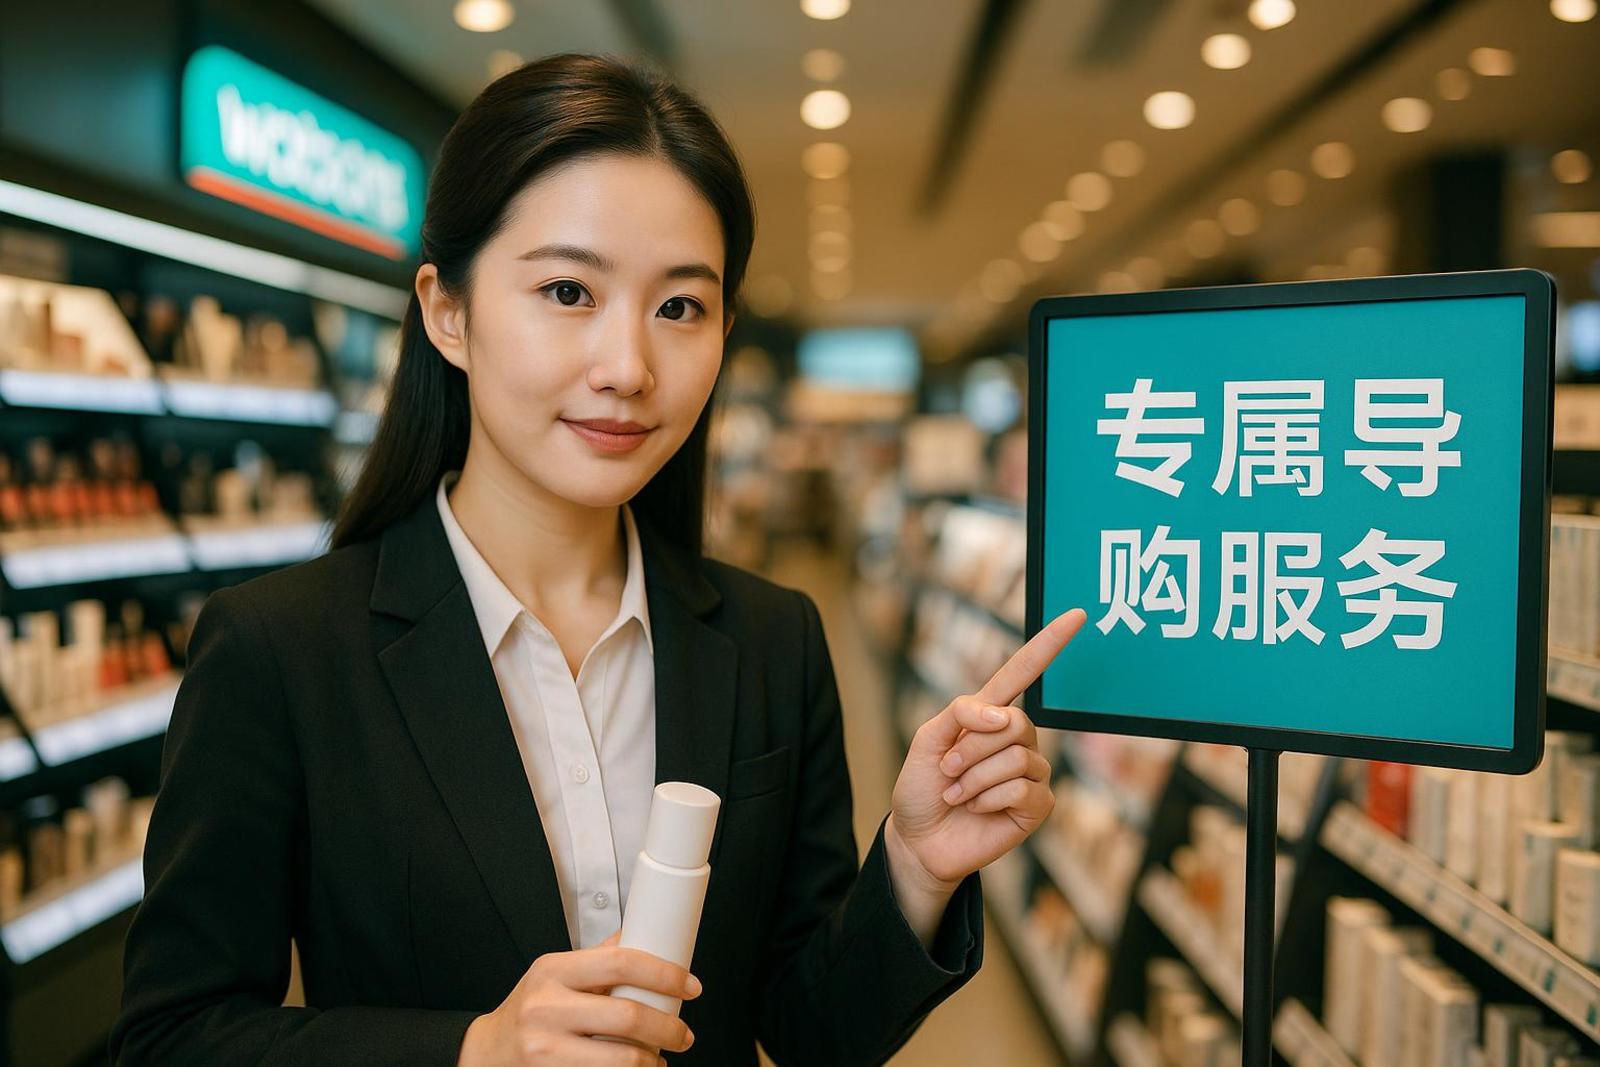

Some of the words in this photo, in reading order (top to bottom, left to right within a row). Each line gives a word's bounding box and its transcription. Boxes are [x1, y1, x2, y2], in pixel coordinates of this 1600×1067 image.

[1097, 378, 1462, 498] 专属导
[1095, 525, 1458, 650] 购服务
